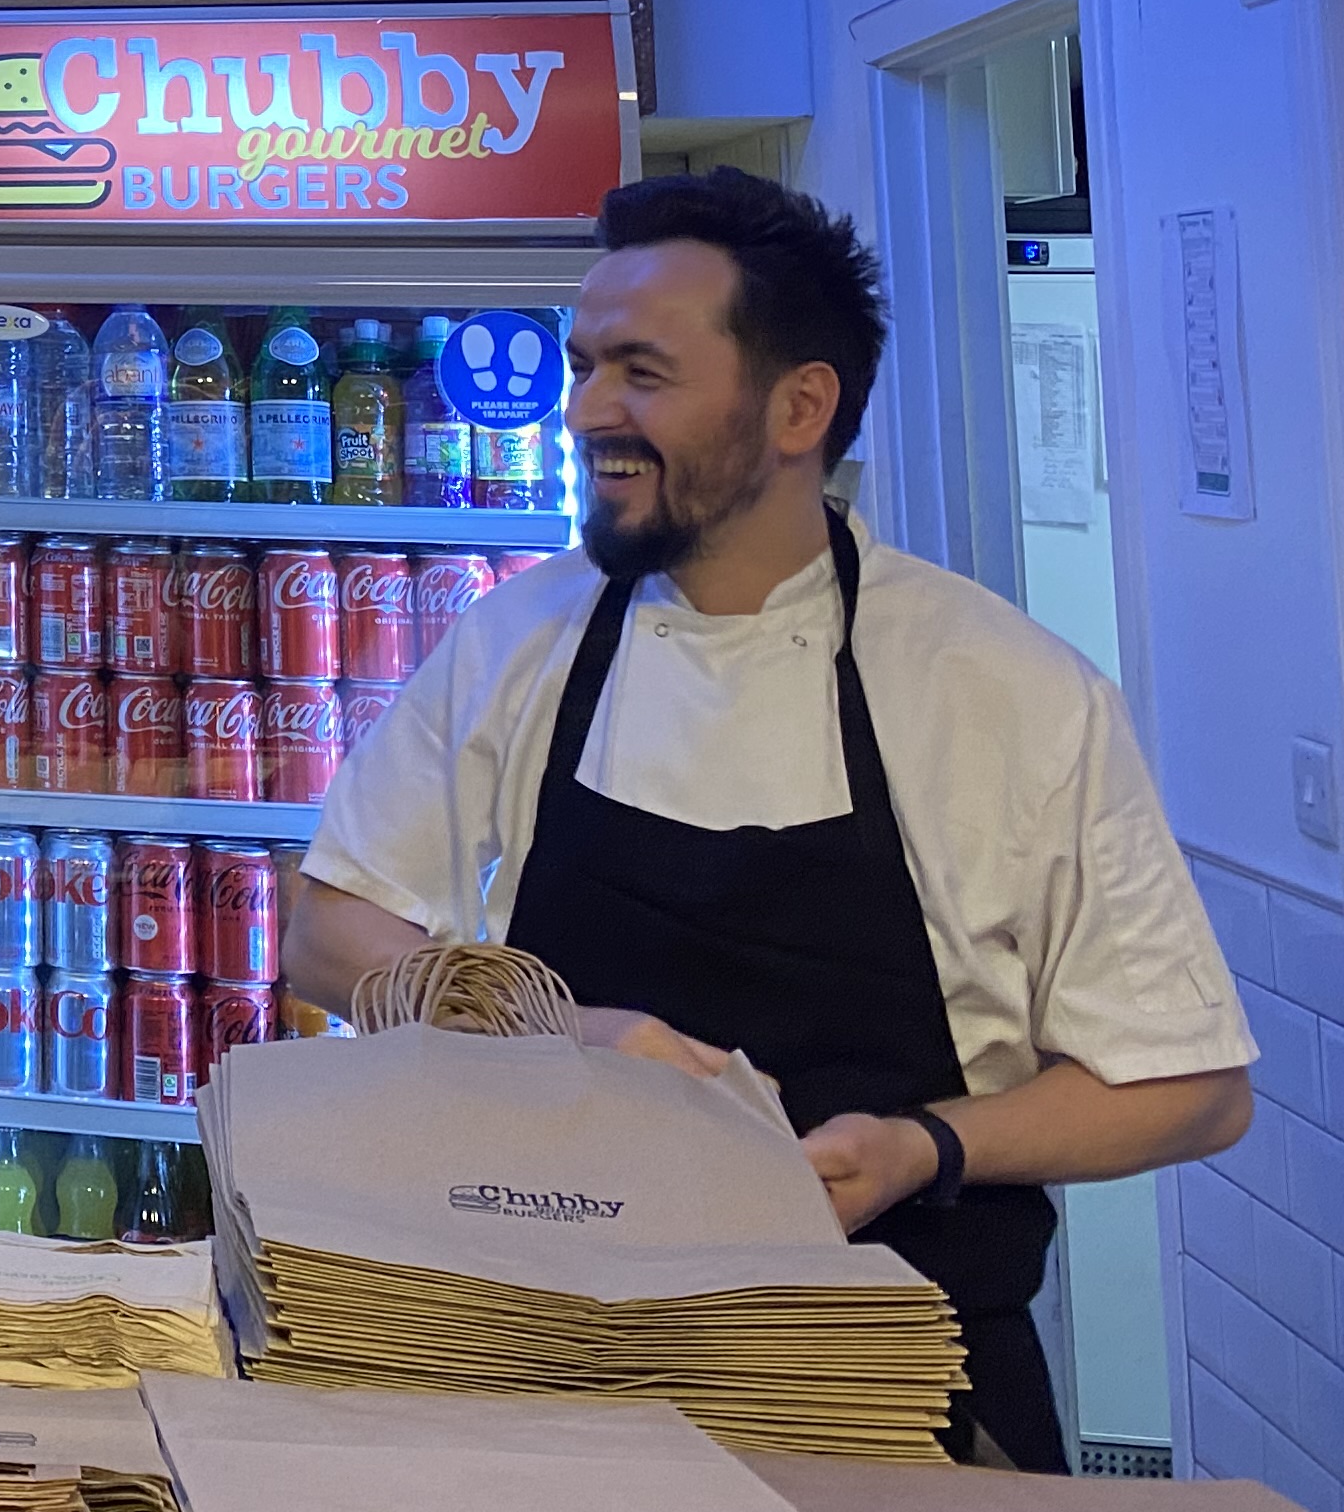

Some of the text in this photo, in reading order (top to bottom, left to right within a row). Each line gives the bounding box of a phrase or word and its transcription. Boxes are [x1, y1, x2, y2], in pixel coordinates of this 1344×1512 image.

[42, 31, 565, 155] Chubby
[237, 113, 492, 182] gourmet
[123, 164, 410, 210] BURGERS
[471, 401, 539, 410] PLEASE KEEP
[481, 410, 531, 419] 1M APART
[341, 434, 368, 448] Fruit
[340, 447, 375, 460] Shoot
[478, 1185, 625, 1218] Chubby
